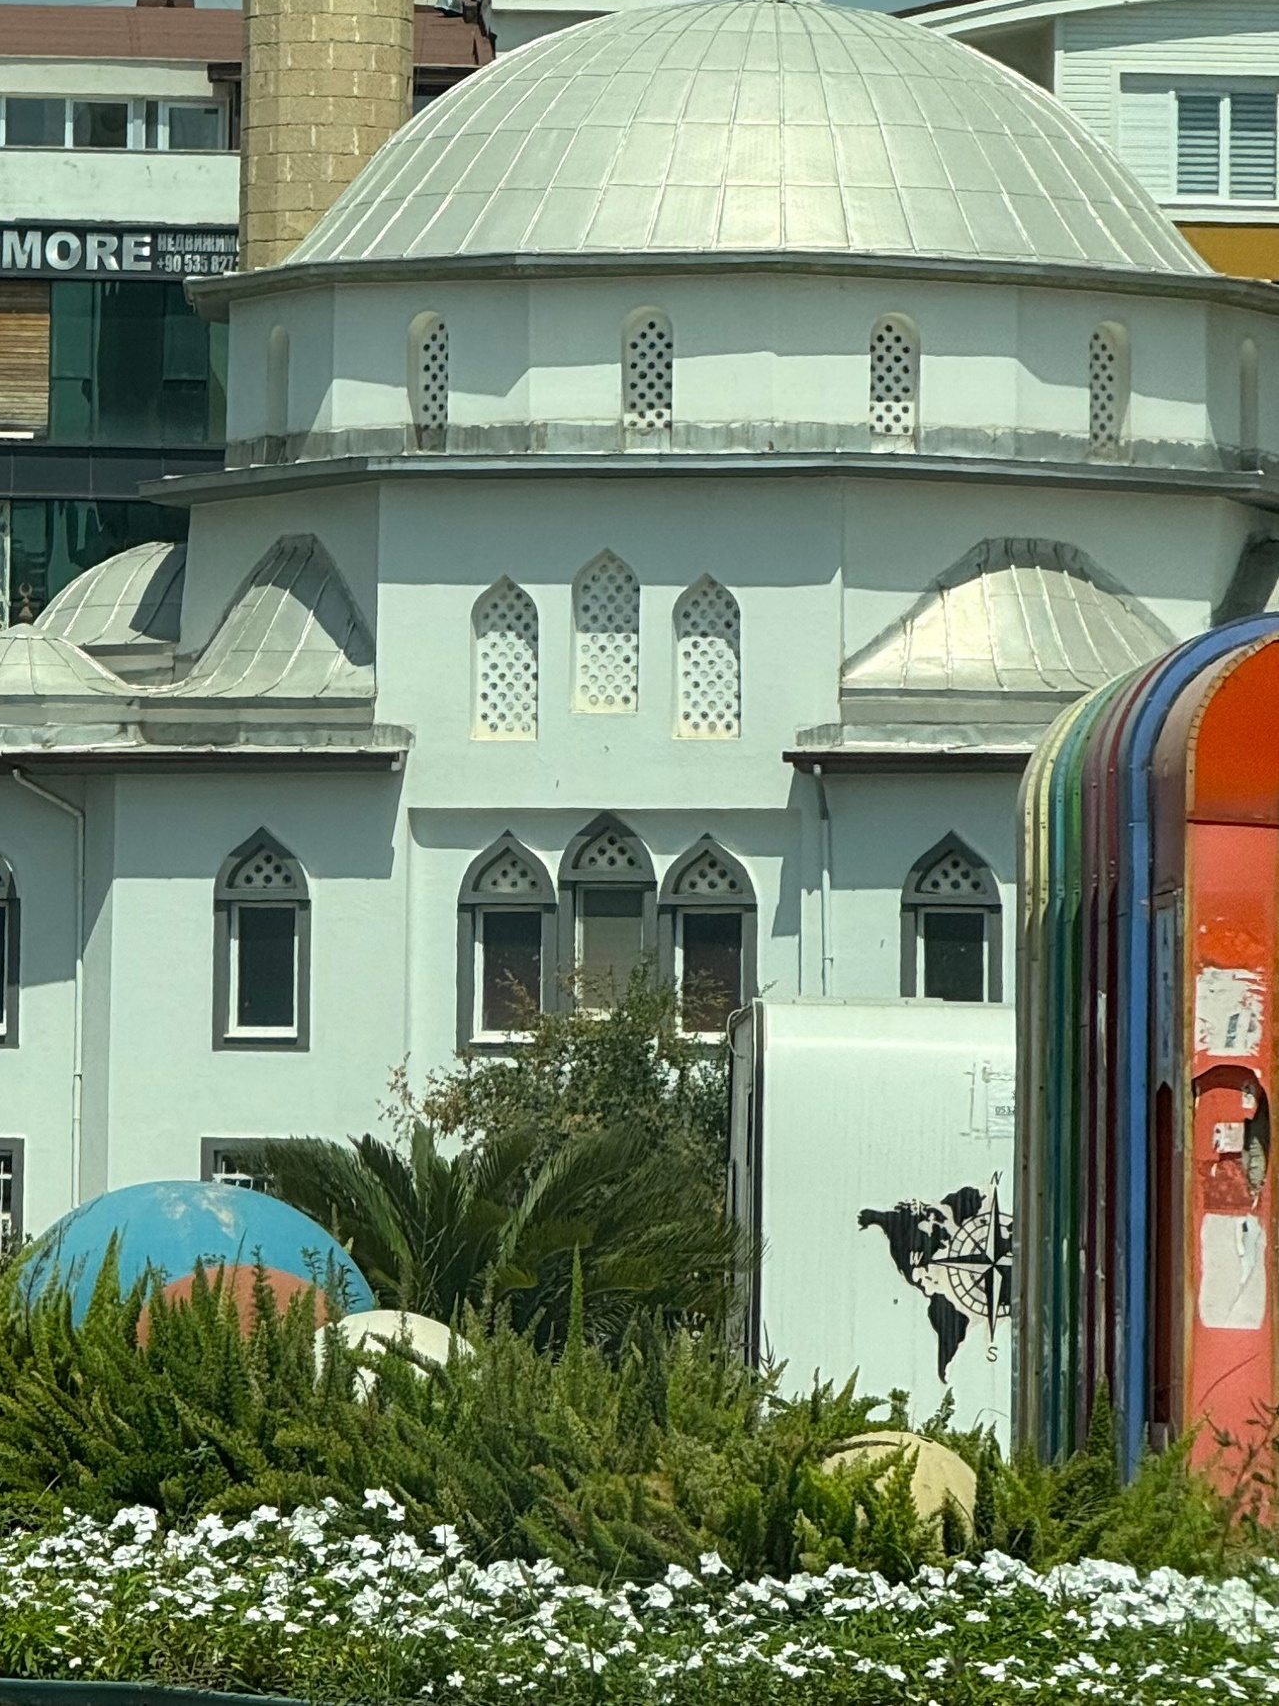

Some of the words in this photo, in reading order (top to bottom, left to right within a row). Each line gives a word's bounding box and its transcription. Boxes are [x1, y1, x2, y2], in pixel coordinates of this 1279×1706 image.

[157, 254, 182, 273] +90
[184, 254, 208, 273] 535
[985, 1346, 999, 1363] S
